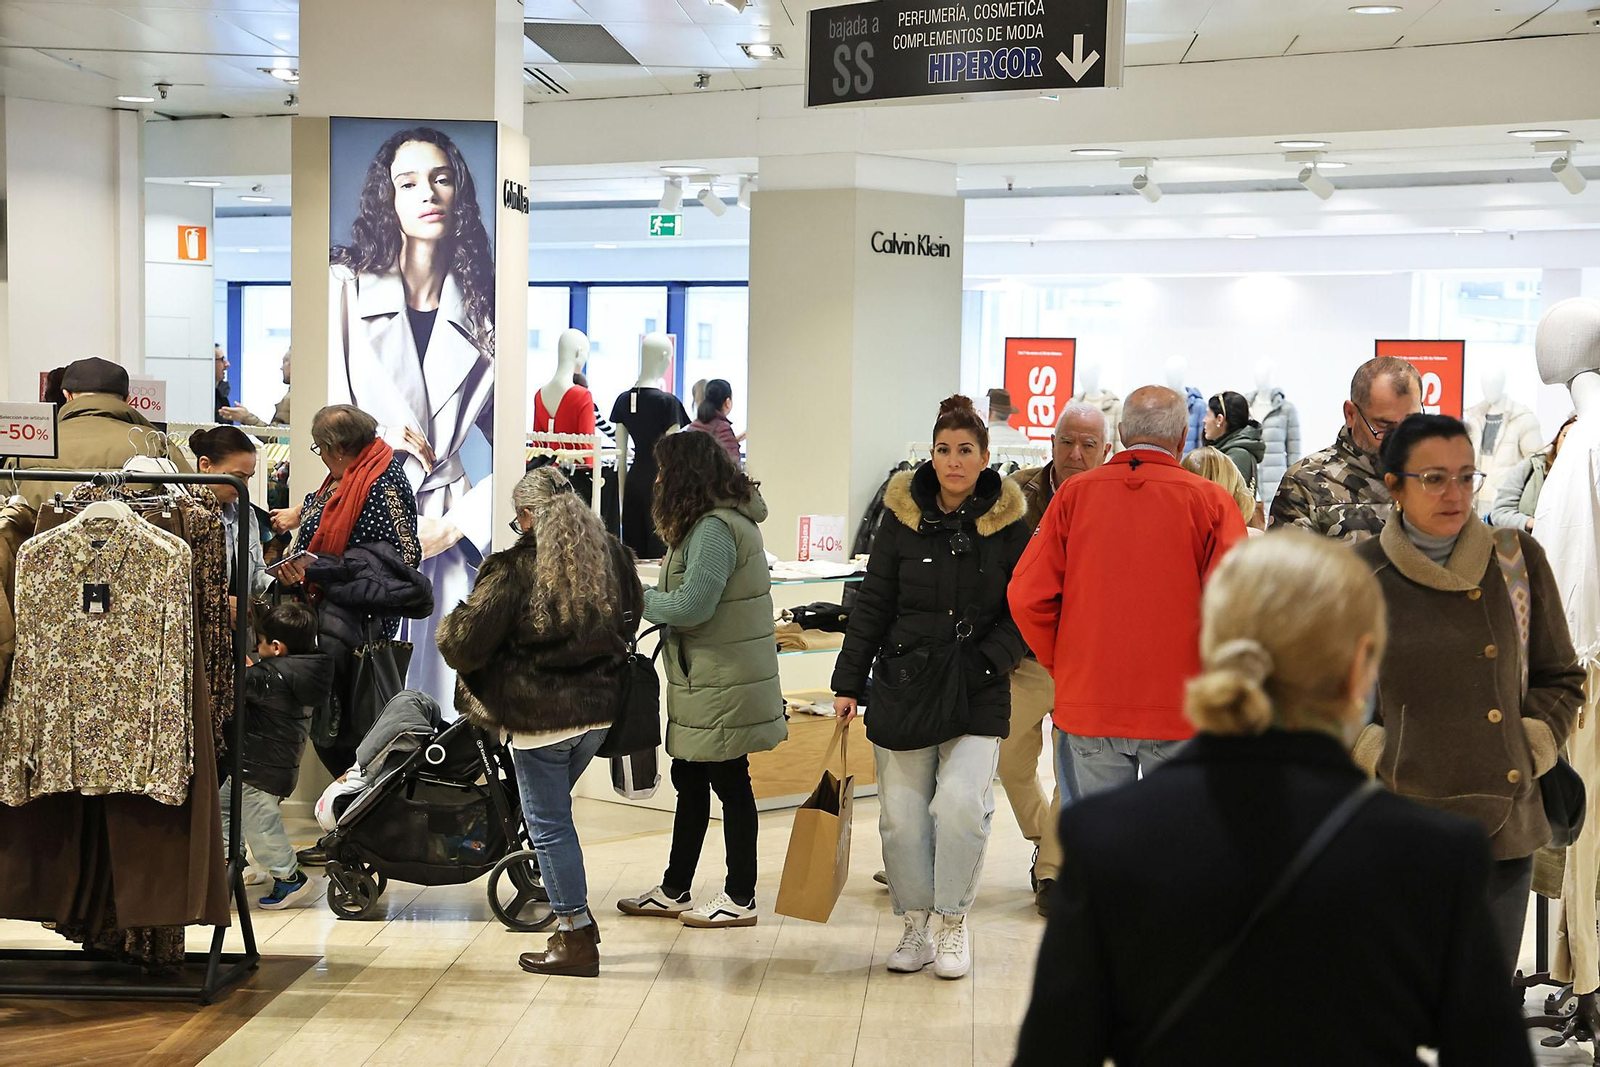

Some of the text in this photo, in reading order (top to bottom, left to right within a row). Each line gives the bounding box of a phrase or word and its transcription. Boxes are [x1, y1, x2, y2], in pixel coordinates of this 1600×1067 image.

[829, 14, 880, 41] bajada a
[898, 3, 970, 27] PERFUMERÍA,
[893, 23, 1045, 50] COMPLEMENTOS DE MODA
[832, 41, 874, 96] SS
[927, 46, 1044, 84] HIPERCOR
[871, 230, 951, 258] Calvin Klein
[129, 386, 156, 397] ODO
[0, 423, 49, 441] -50%
[812, 536, 842, 551] -40%
